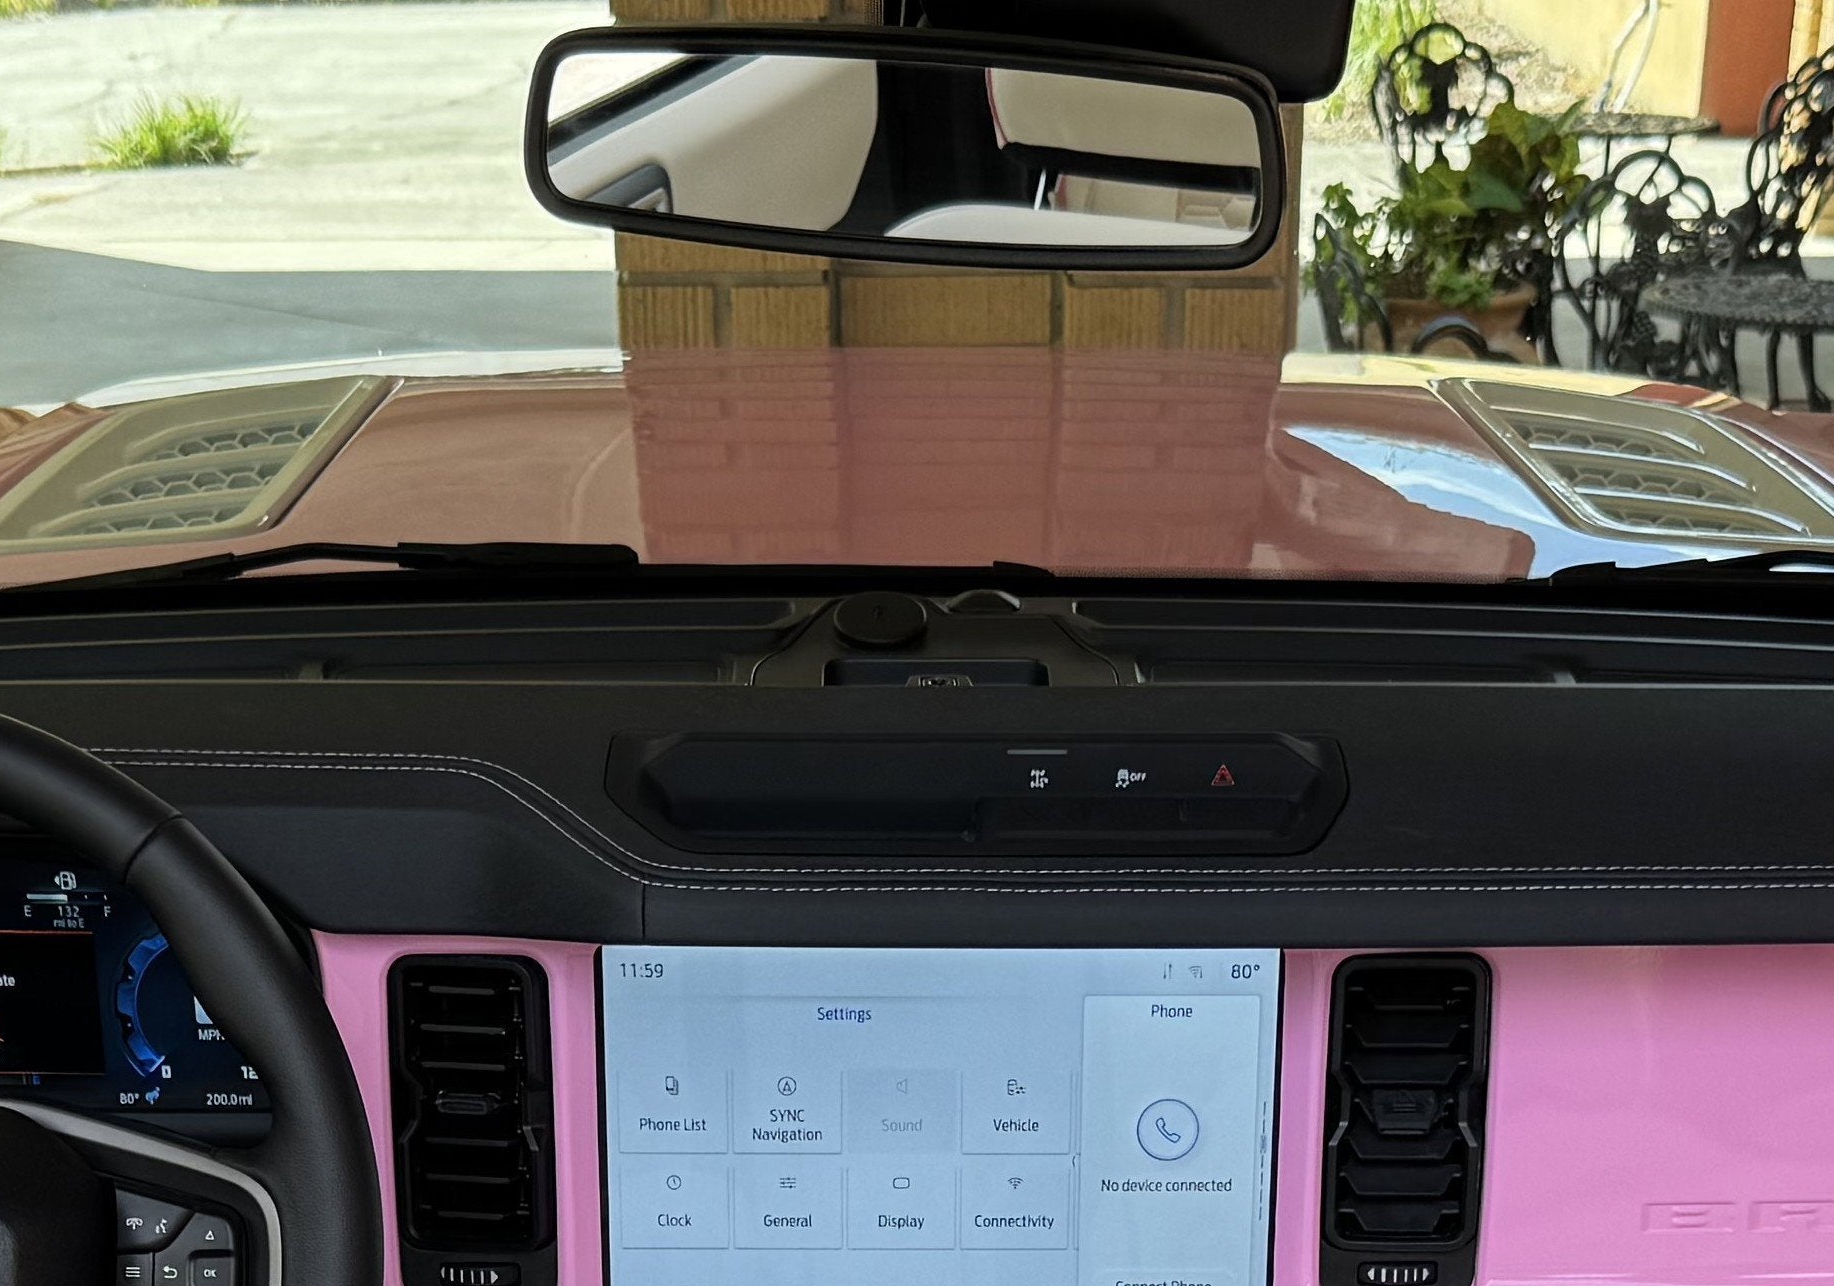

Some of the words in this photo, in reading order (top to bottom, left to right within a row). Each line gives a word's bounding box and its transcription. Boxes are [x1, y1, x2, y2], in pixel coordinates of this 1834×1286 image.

[24, 905, 32, 917] E
[58, 906, 80, 918] 132
[104, 906, 111, 917] F
[620, 963, 664, 979] 11:59
[1231, 963, 1261, 980] 80°
[817, 1005, 872, 1024] Settings
[1150, 1004, 1193, 1019] Phone
[161, 1065, 172, 1079] 0
[206, 1094, 238, 1106] 200.0
[770, 1109, 805, 1123] SYNC
[639, 1117, 680, 1133] Phone
[682, 1117, 707, 1133] List
[881, 1118, 923, 1133] Sound
[993, 1118, 1039, 1133] Vehicle
[752, 1127, 823, 1144] Navigation
[1101, 1179, 1119, 1192] No
[1121, 1178, 1163, 1192] device
[1165, 1178, 1232, 1192] connected
[657, 1214, 692, 1229] Clock
[763, 1214, 813, 1229] General
[877, 1214, 925, 1232] Display
[974, 1214, 1054, 1232] Connectivity
